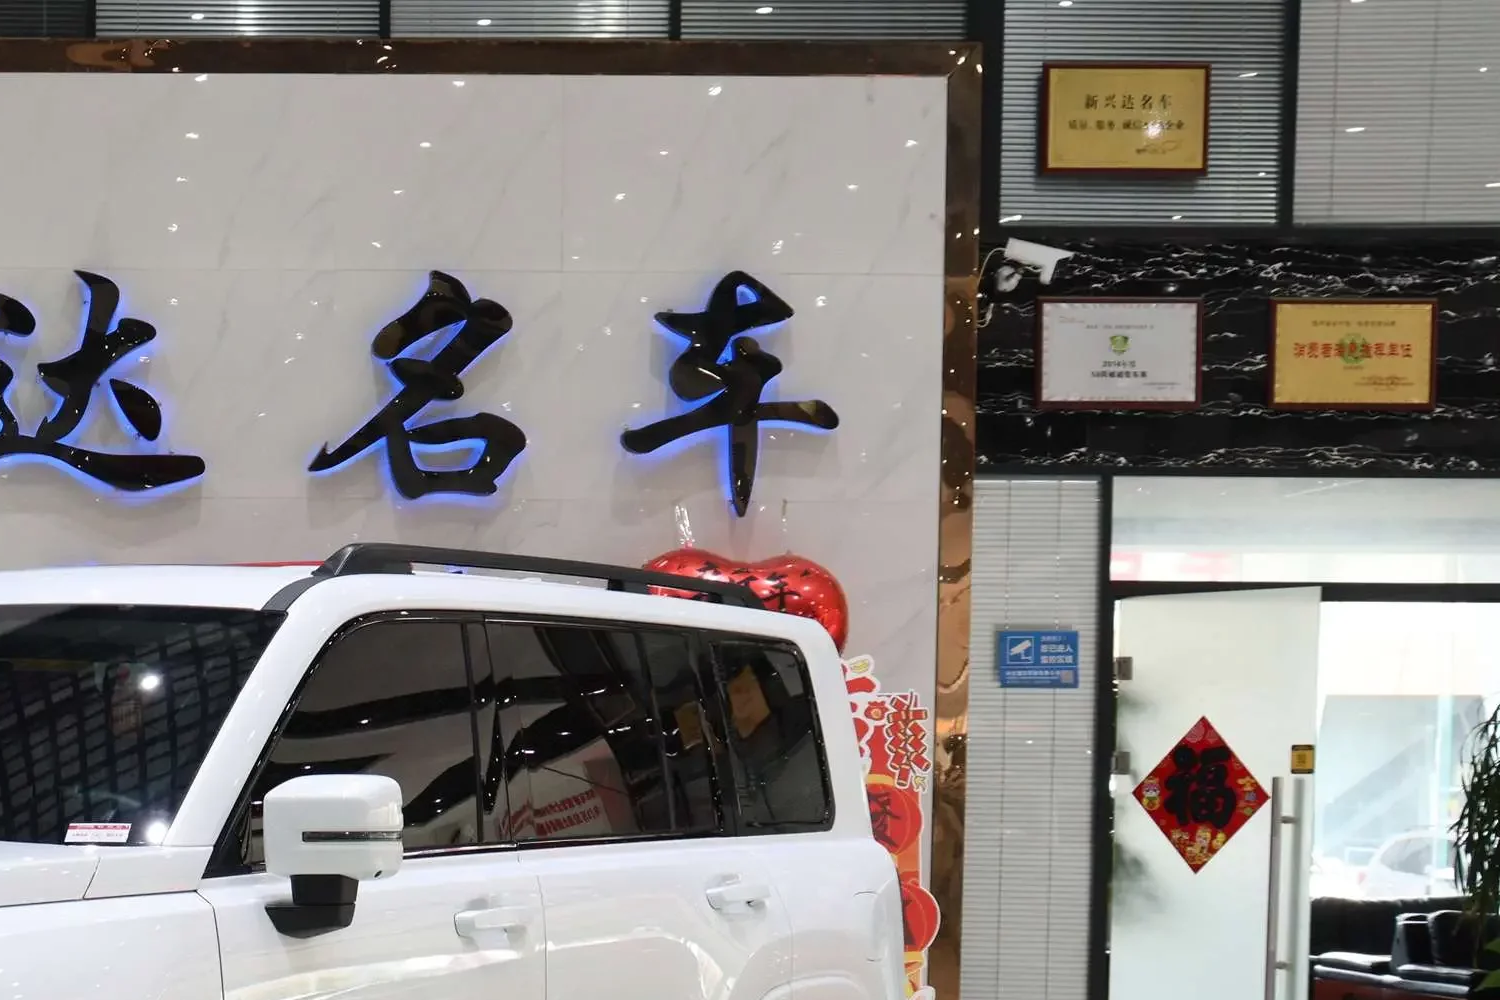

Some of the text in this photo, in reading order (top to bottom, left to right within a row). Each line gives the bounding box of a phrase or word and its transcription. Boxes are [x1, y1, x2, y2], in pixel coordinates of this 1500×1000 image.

[1085, 94, 1173, 110] 新兴达名车
